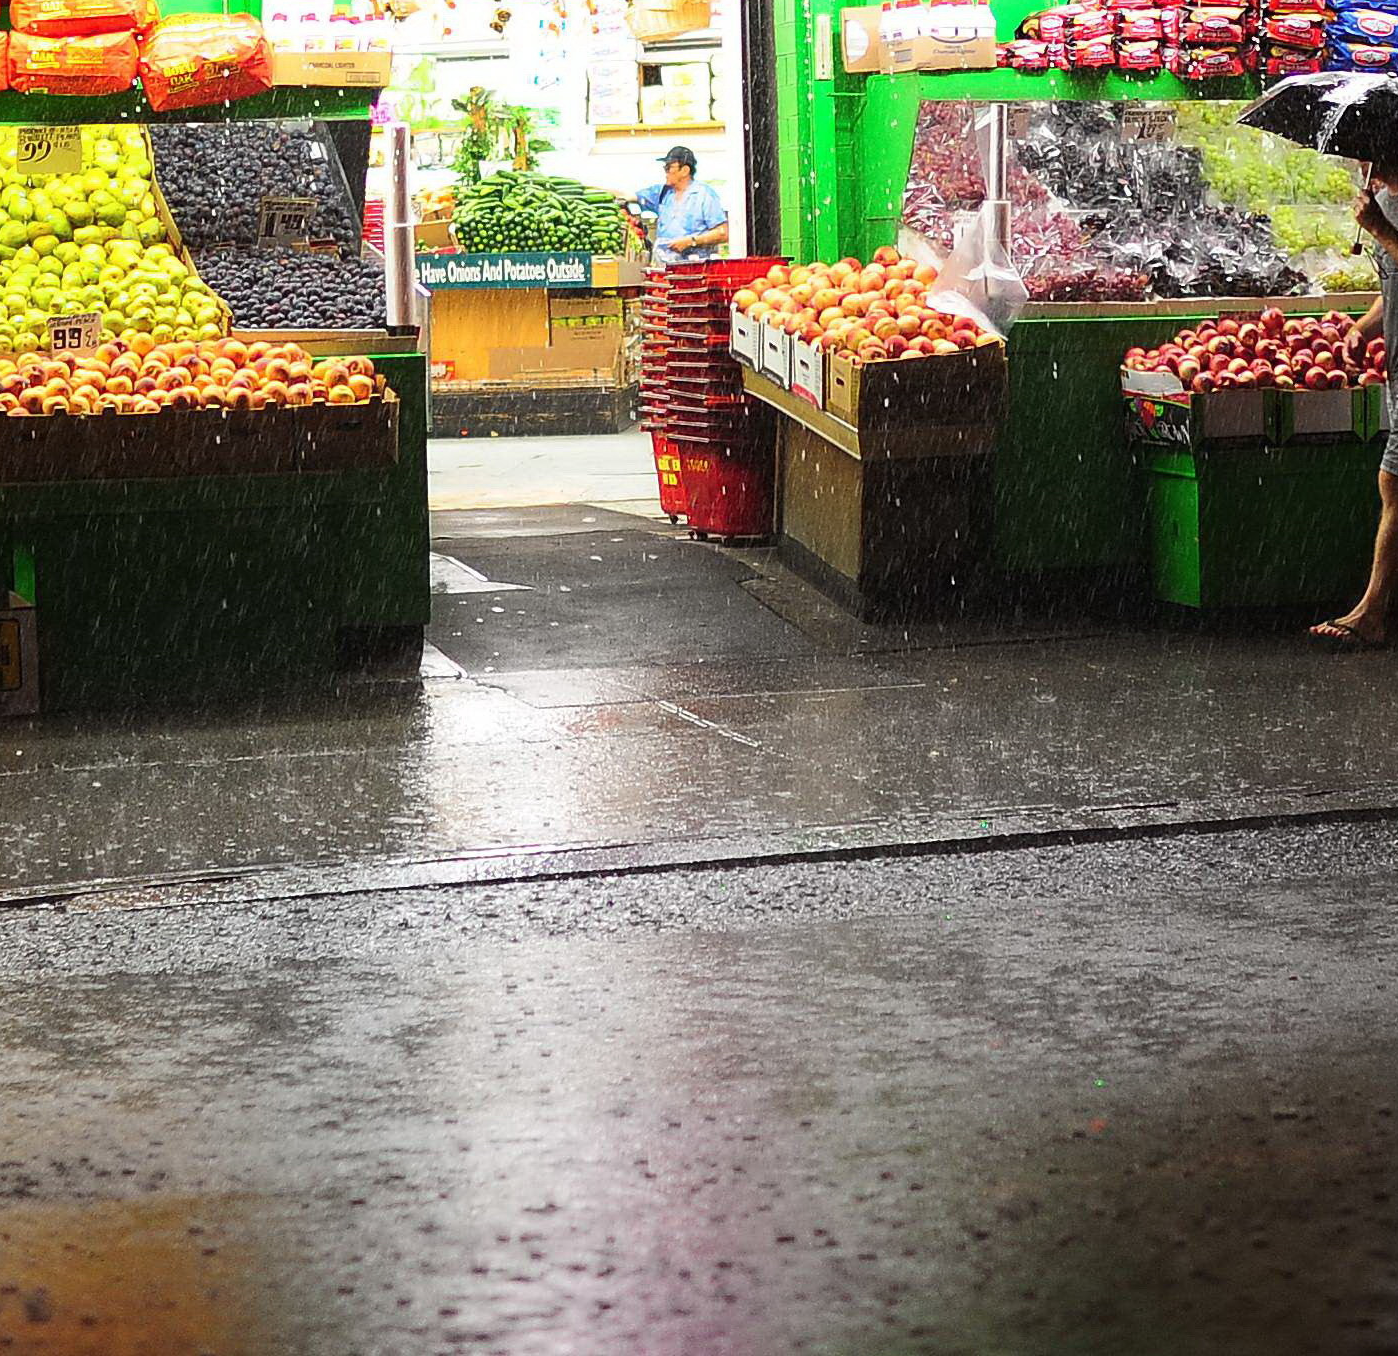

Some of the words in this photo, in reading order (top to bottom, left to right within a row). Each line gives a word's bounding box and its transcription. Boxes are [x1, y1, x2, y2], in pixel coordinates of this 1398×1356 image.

[421, 260, 446, 283] Have
[448, 259, 482, 283] Onions
[483, 259, 503, 281] And
[504, 258, 546, 281] Potatoes
[547, 257, 585, 281] Outside
[53, 328, 83, 350] 99
